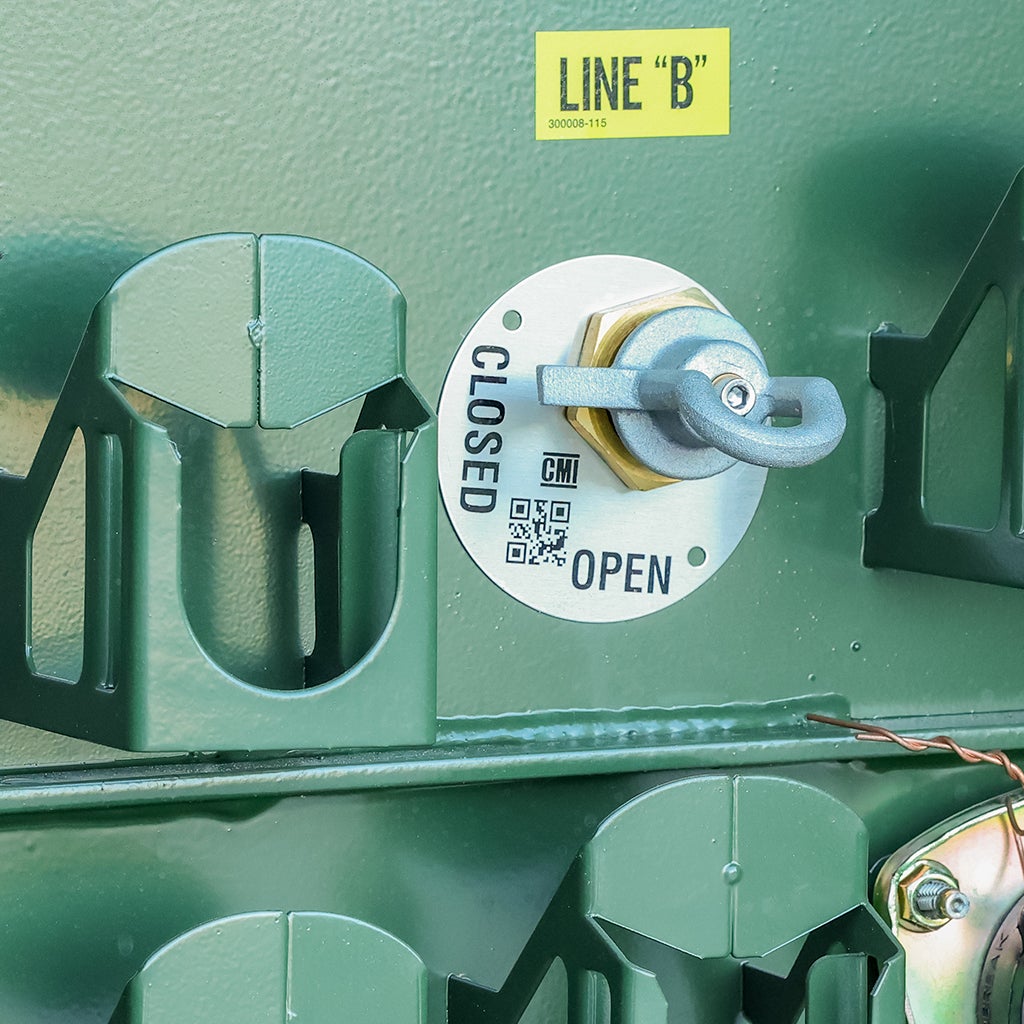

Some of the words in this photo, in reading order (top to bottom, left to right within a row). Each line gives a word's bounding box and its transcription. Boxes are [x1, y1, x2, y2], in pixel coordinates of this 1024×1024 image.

[560, 56, 642, 111] LINE
[655, 55, 707, 109] “B”
[548, 118, 607, 129] 300008-115
[460, 345, 510, 513] CLOSED
[541, 456, 578, 484] CMI
[572, 549, 672, 594] OPEN
